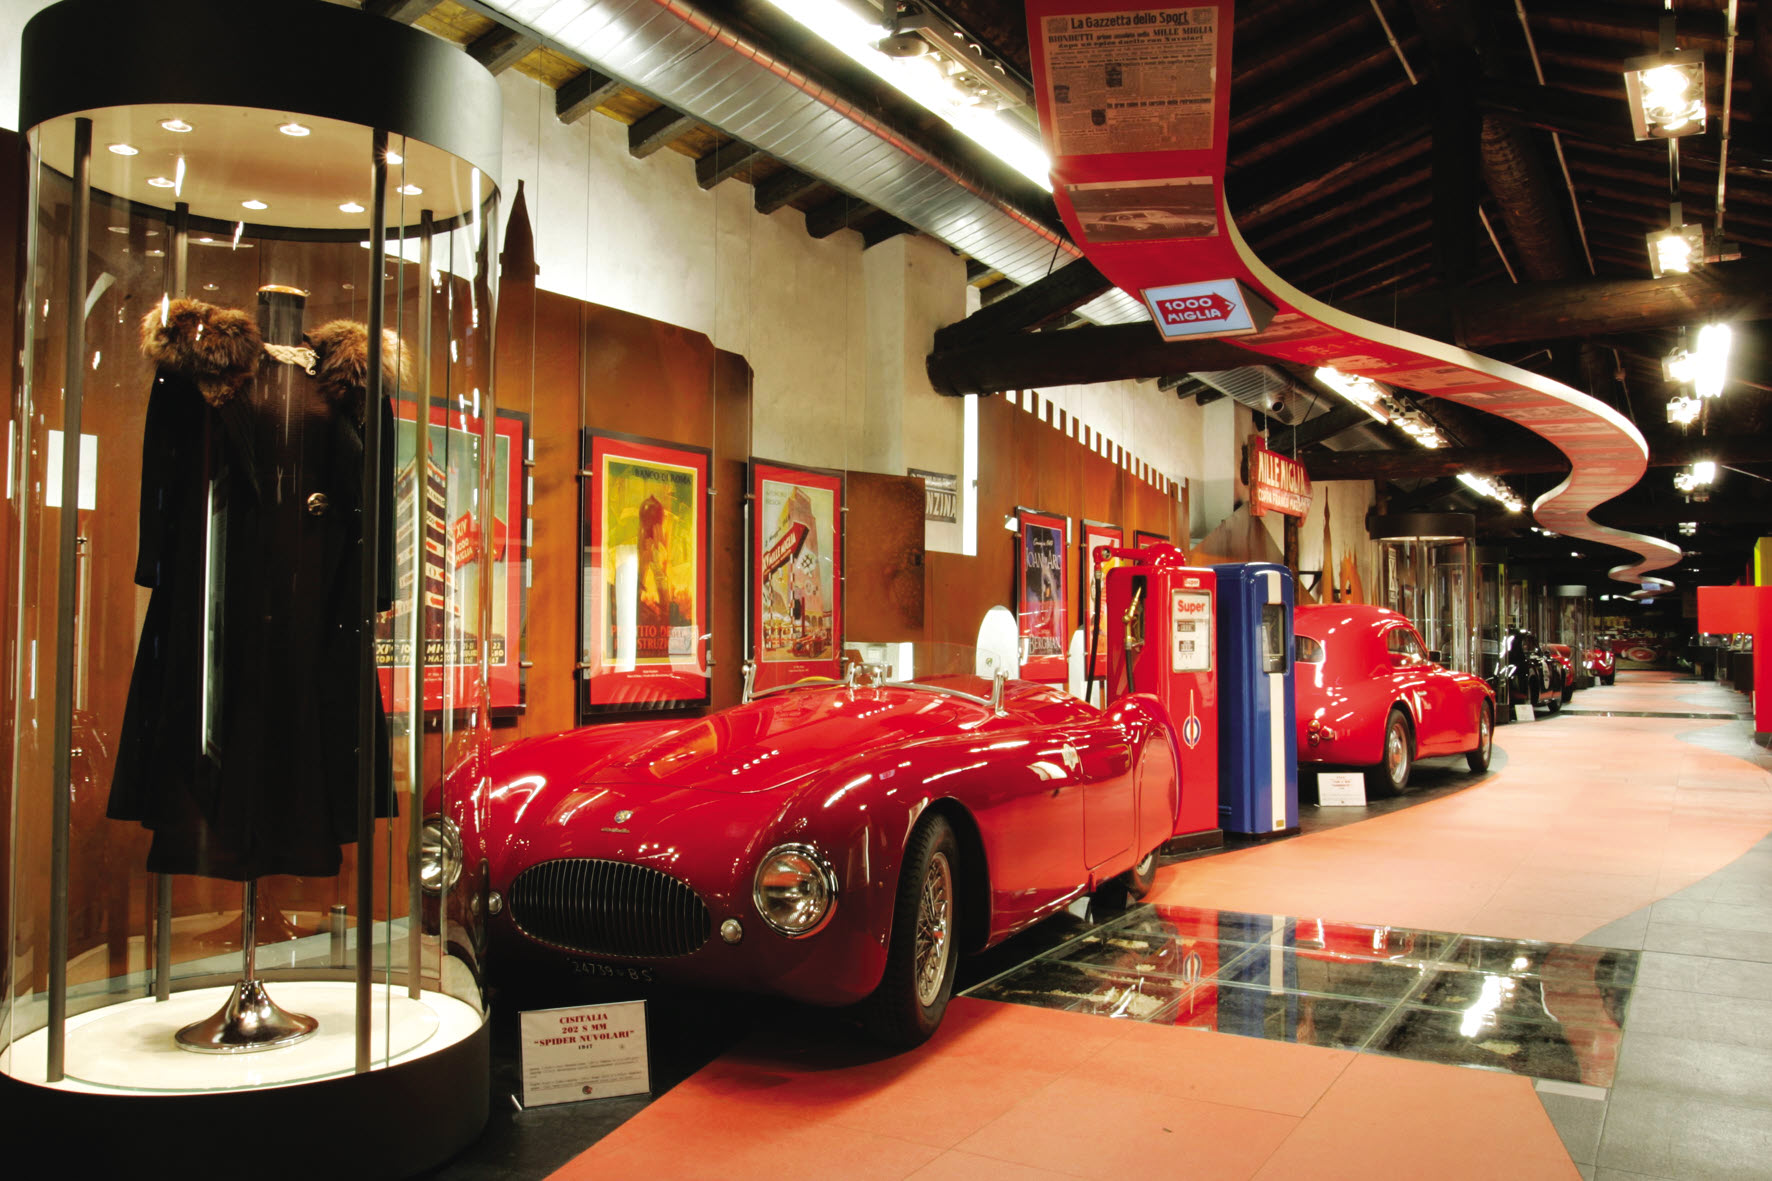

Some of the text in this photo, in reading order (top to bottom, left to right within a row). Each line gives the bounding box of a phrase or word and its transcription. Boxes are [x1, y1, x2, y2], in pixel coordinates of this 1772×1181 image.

[1070, 11, 1188, 29] La Gazzetta dello Sport
[1153, 27, 1180, 36] MILLE
[1183, 26, 1213, 34] MIGLIA
[1164, 297, 1213, 311] 1000
[1167, 308, 1222, 323] MIGLIA
[671, 473, 692, 485] ROMA
[1258, 450, 1305, 496] MILLE MIGLIA
[925, 490, 957, 518] NZINA
[456, 538, 470, 552] 1000
[1025, 546, 1062, 572] JOAN ARC
[1177, 599, 1206, 615] Super
[1030, 634, 1061, 654] BERGMAN
[559, 1013, 608, 1025] CISITALIA
[562, 1026, 578, 1034] 202
[590, 1023, 607, 1032] MM
[534, 1030, 635, 1047] "SPIDER NUVOLARI"
